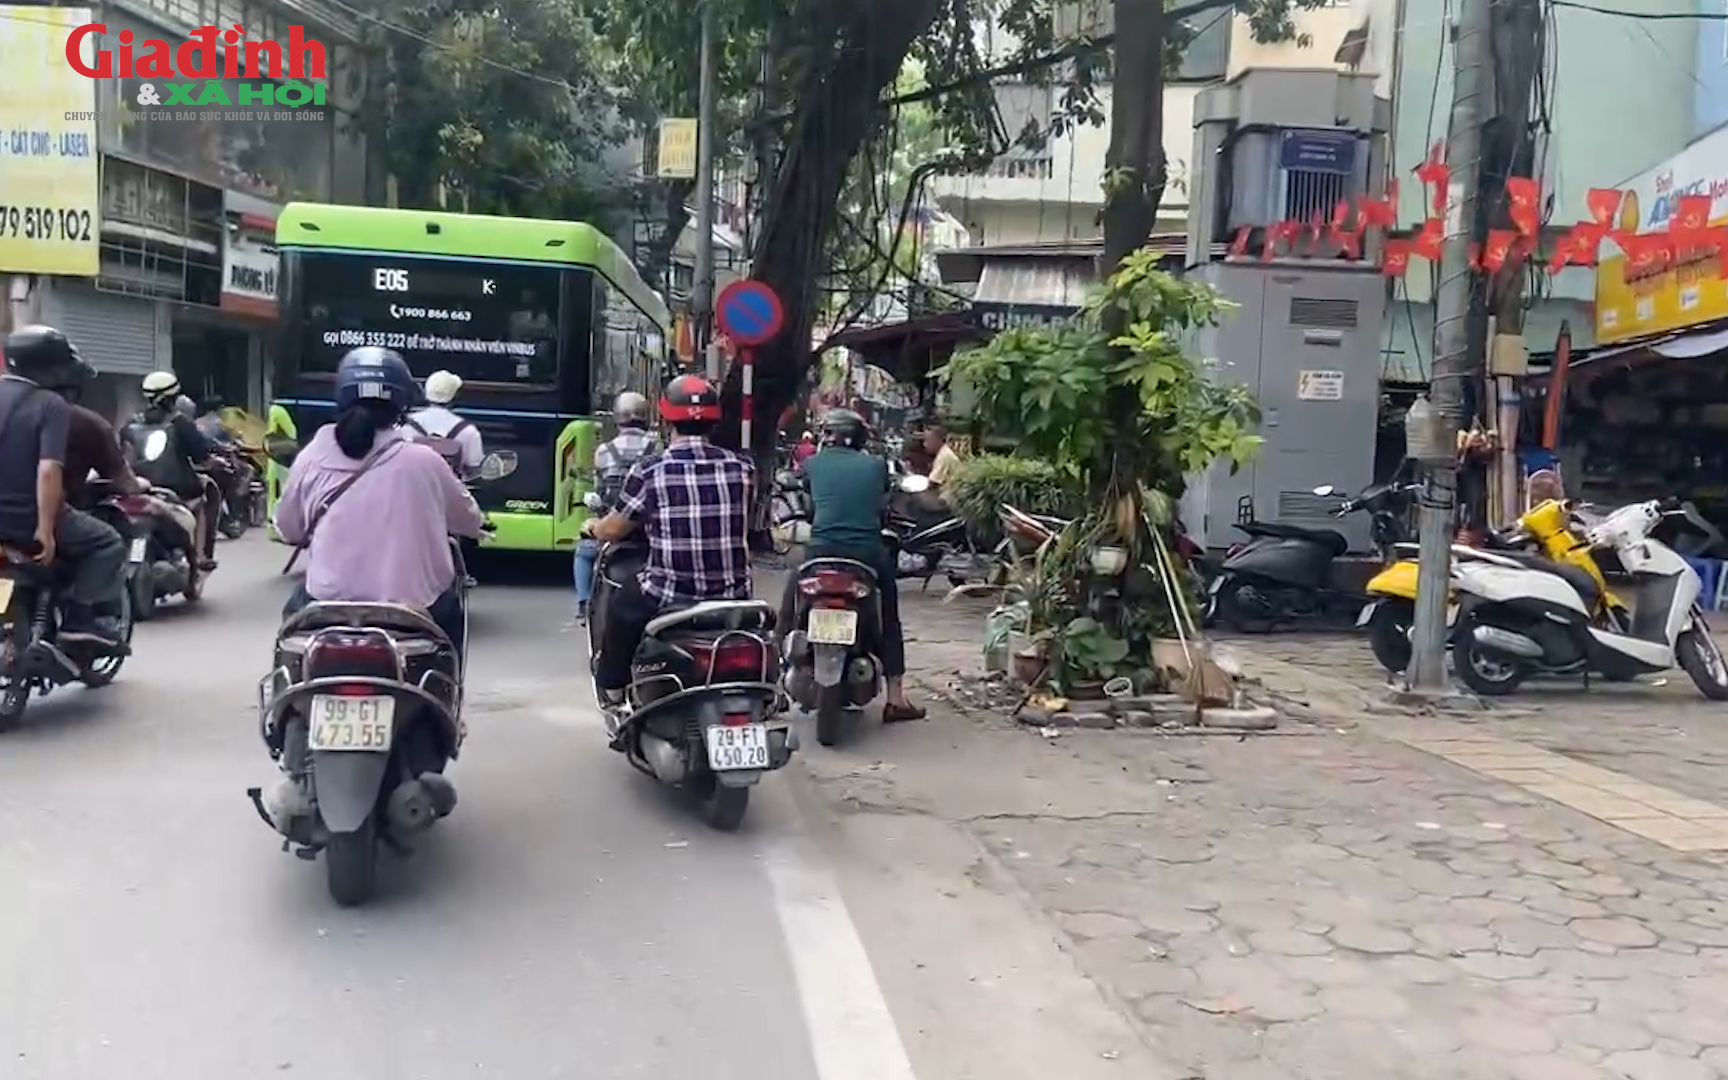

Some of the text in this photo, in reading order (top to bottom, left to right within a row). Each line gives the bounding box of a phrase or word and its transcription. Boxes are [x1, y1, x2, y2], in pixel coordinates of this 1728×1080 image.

[25, 206, 54, 239] 519
[59, 208, 91, 241] 102
[375, 268, 409, 291] E05
[399, 306, 426, 318] 1900
[427, 308, 450, 319] 866
[323, 331, 340, 347] GỌI
[386, 332, 406, 348] 222
[316, 724, 386, 747] 473.55
[716, 727, 758, 747] 29-F1
[714, 745, 766, 767] 450.20
